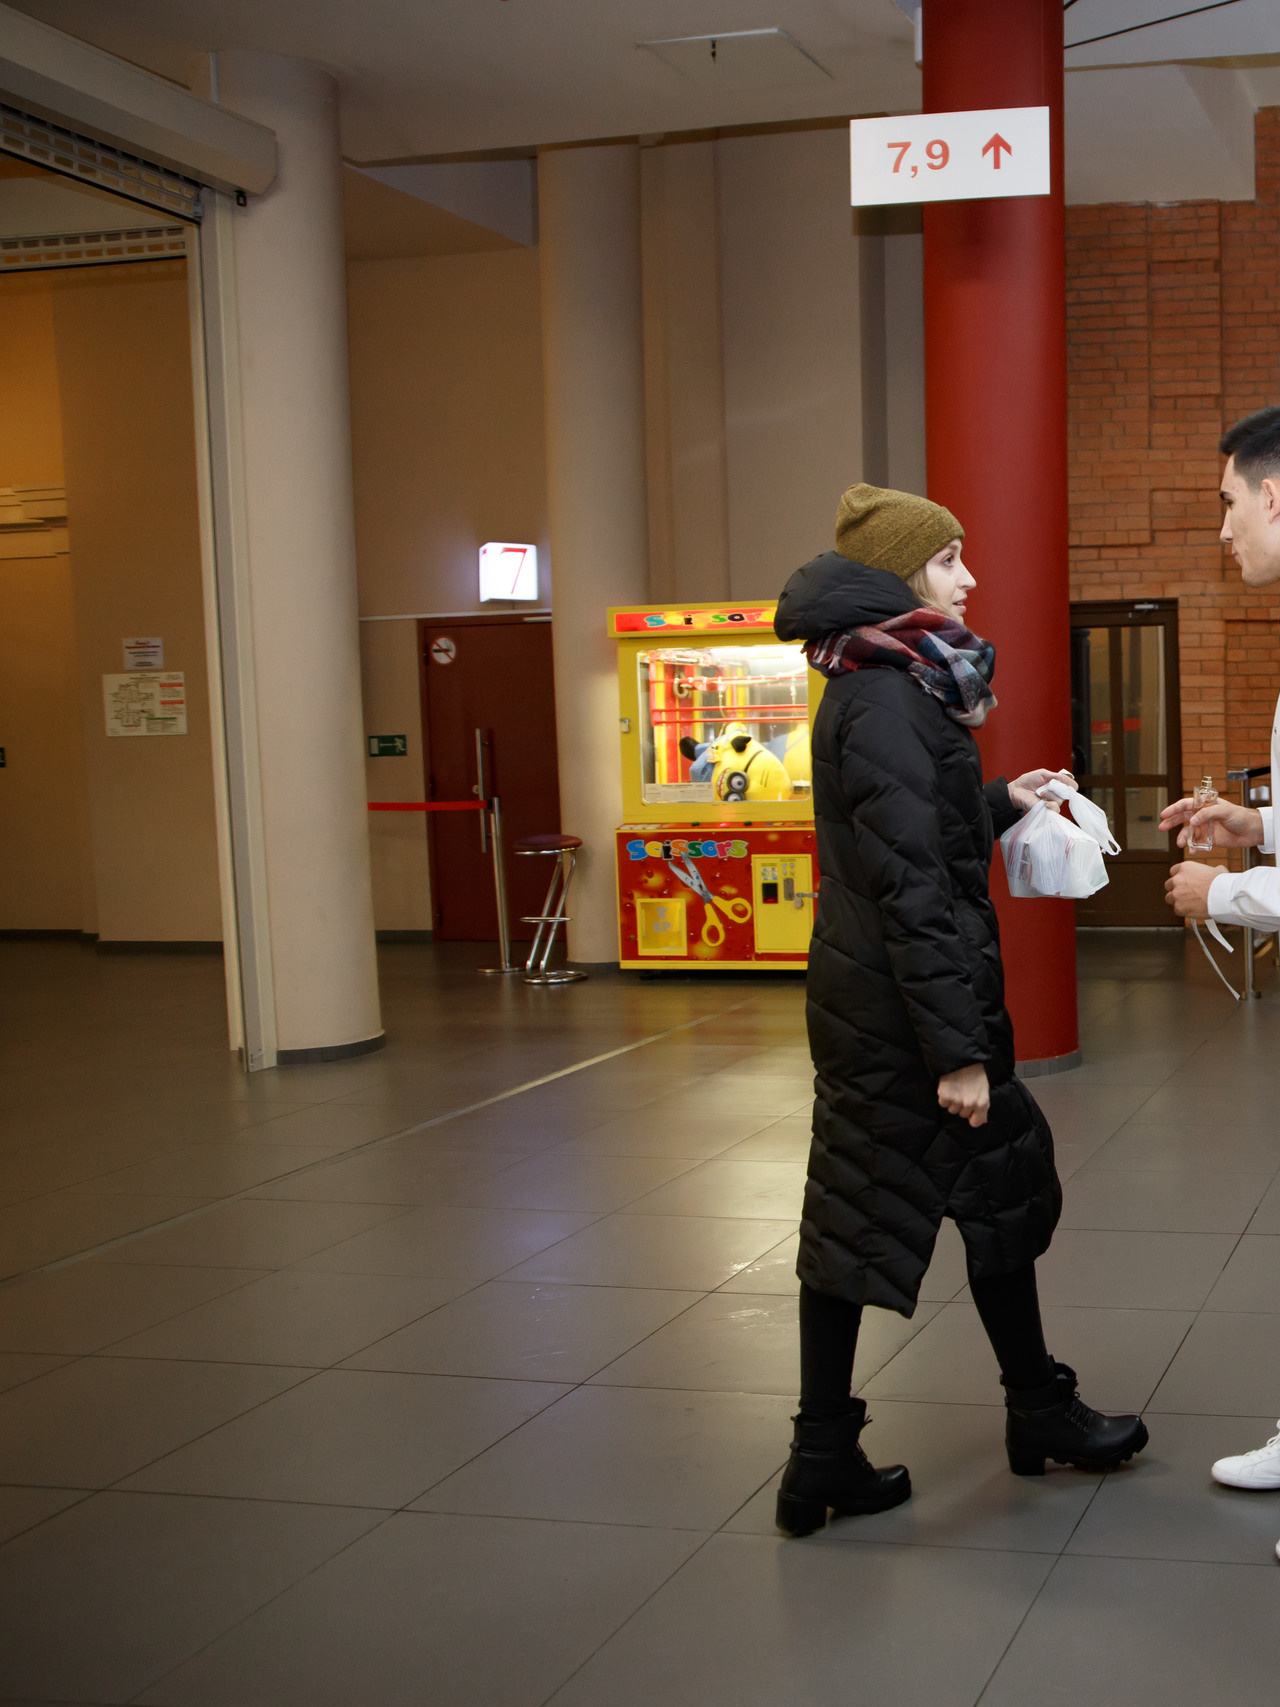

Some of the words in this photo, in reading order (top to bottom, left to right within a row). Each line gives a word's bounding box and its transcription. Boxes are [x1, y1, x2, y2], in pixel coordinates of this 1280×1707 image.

[886, 138, 951, 179] 7,9
[501, 546, 528, 595] 7
[626, 838, 749, 861] Scissors
